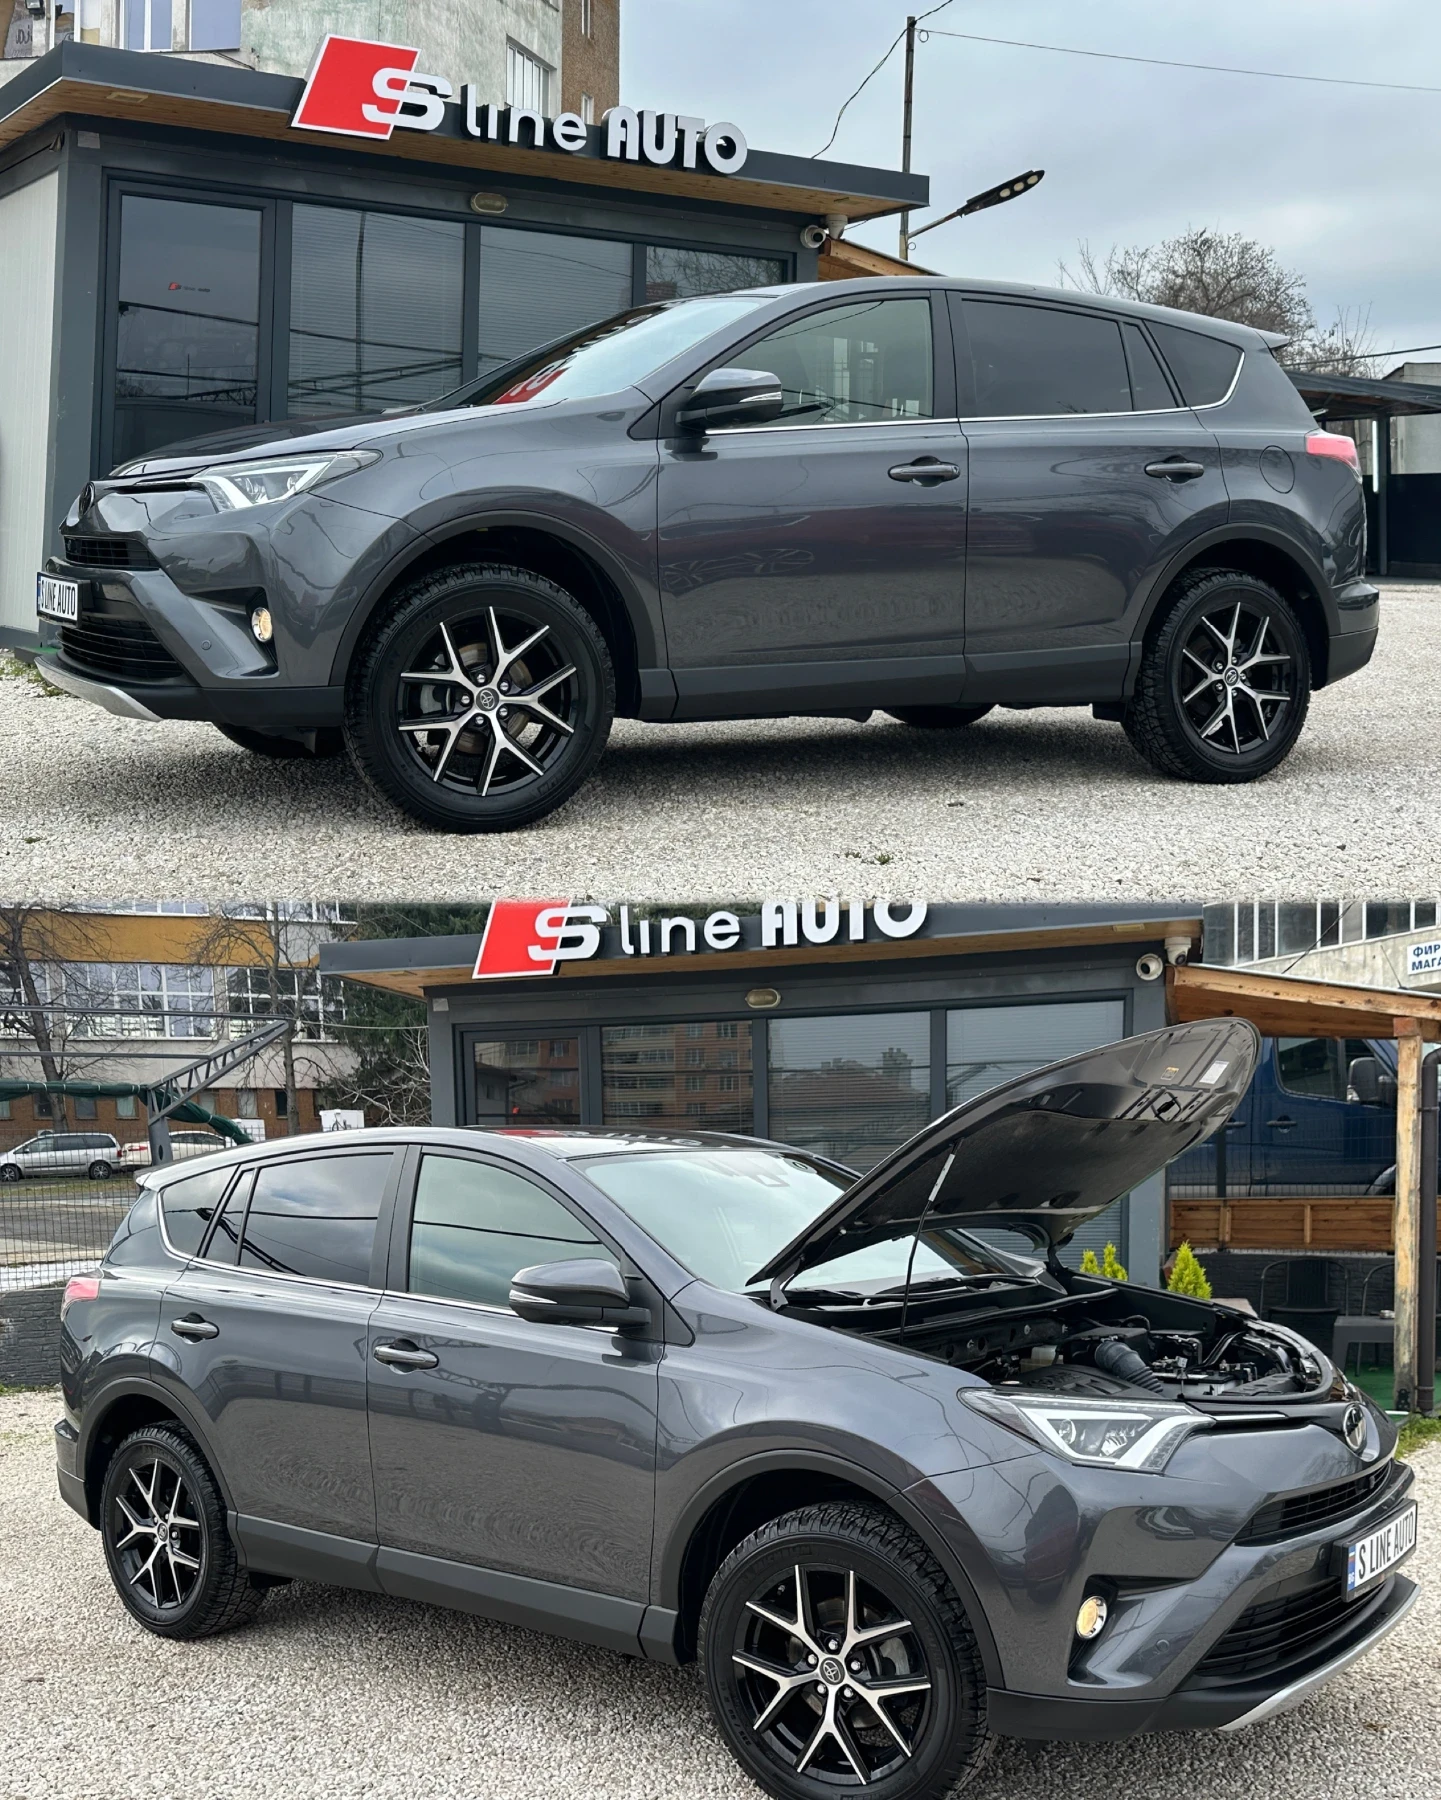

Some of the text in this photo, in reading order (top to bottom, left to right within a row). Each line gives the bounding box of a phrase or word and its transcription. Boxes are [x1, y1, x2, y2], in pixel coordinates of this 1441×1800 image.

[361, 67, 453, 131] S
[604, 105, 748, 174] AUTO
[45, 581, 56, 611] LINE
[57, 584, 75, 616] AUTO
[528, 905, 607, 961] S
[1358, 1511, 1414, 1579] S LINE AUTO
